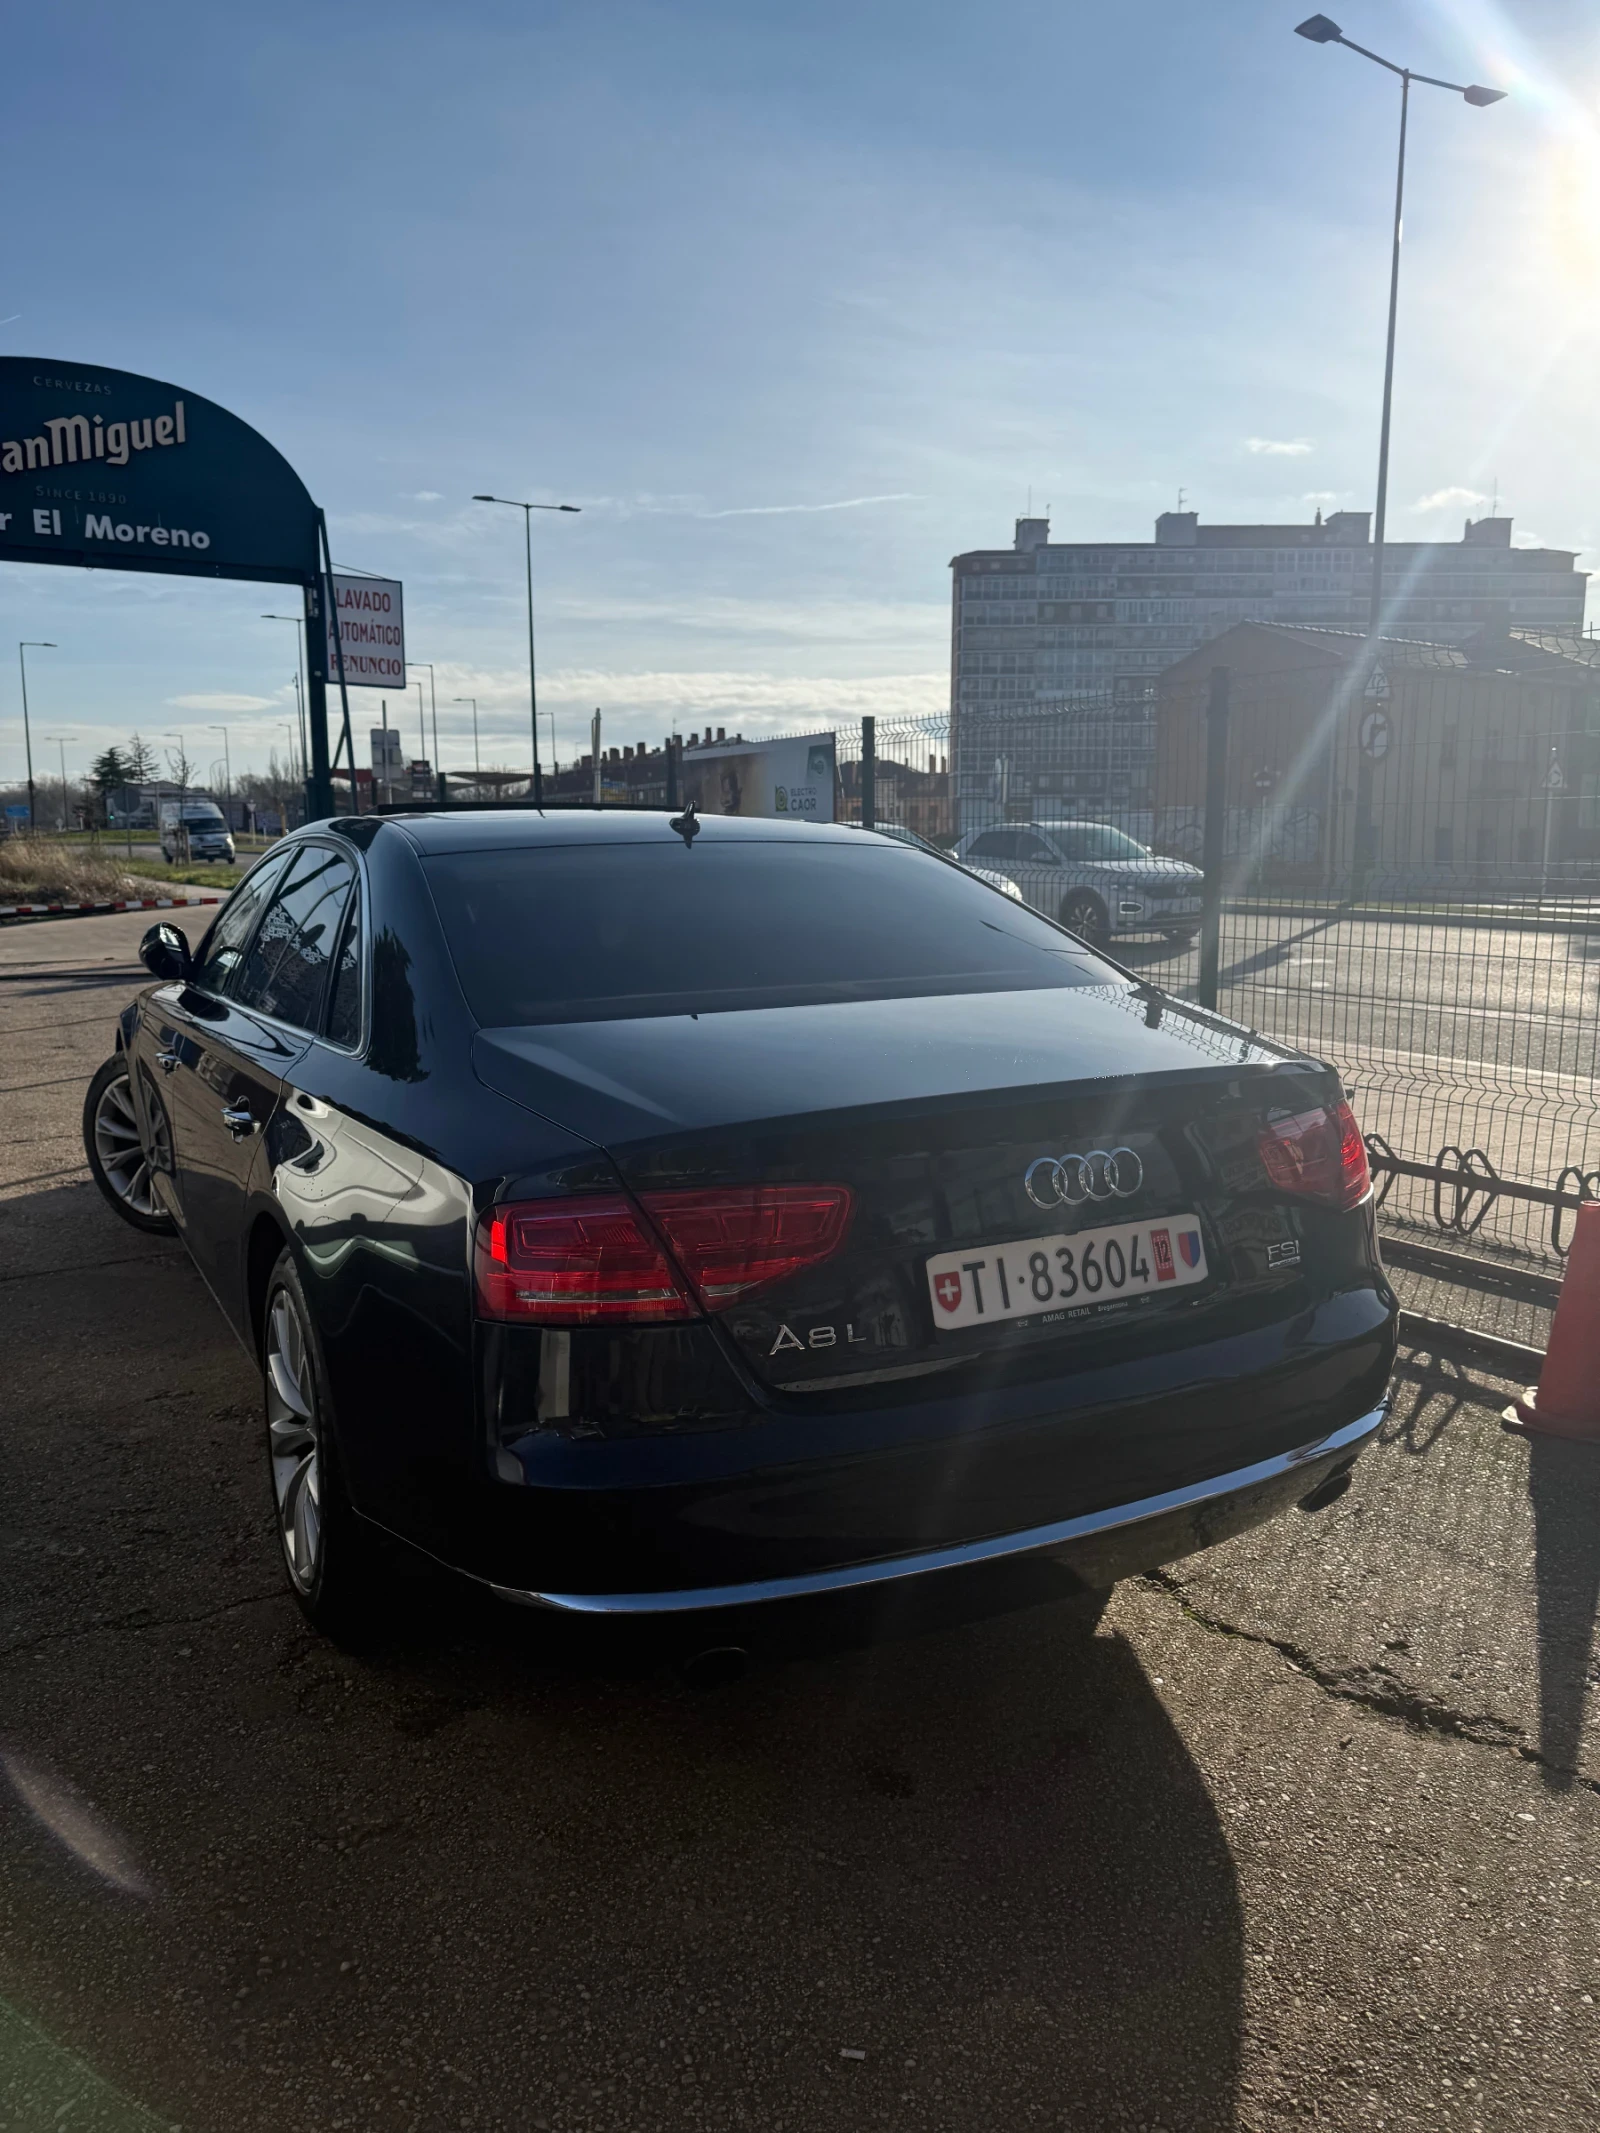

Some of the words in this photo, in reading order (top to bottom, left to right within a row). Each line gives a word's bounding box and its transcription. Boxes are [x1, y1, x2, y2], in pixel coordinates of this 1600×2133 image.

[33, 376, 112, 395] CERVEZAS
[0, 401, 186, 473] anMiguel
[36, 485, 82, 500] SINCE
[88, 491, 127, 505] 1890
[32, 508, 62, 536] El
[84, 514, 211, 549] Moreno
[335, 587, 391, 613] LAVADO
[791, 787, 817, 797] ELECTRO
[791, 799, 816, 812] CAOR
[1267, 1240, 1300, 1261] FSI
[1042, 1311, 1065, 1324] AMAG
[1068, 1307, 1092, 1319] RETAIL
[768, 1323, 837, 1356] A8
[846, 1323, 867, 1343] L
